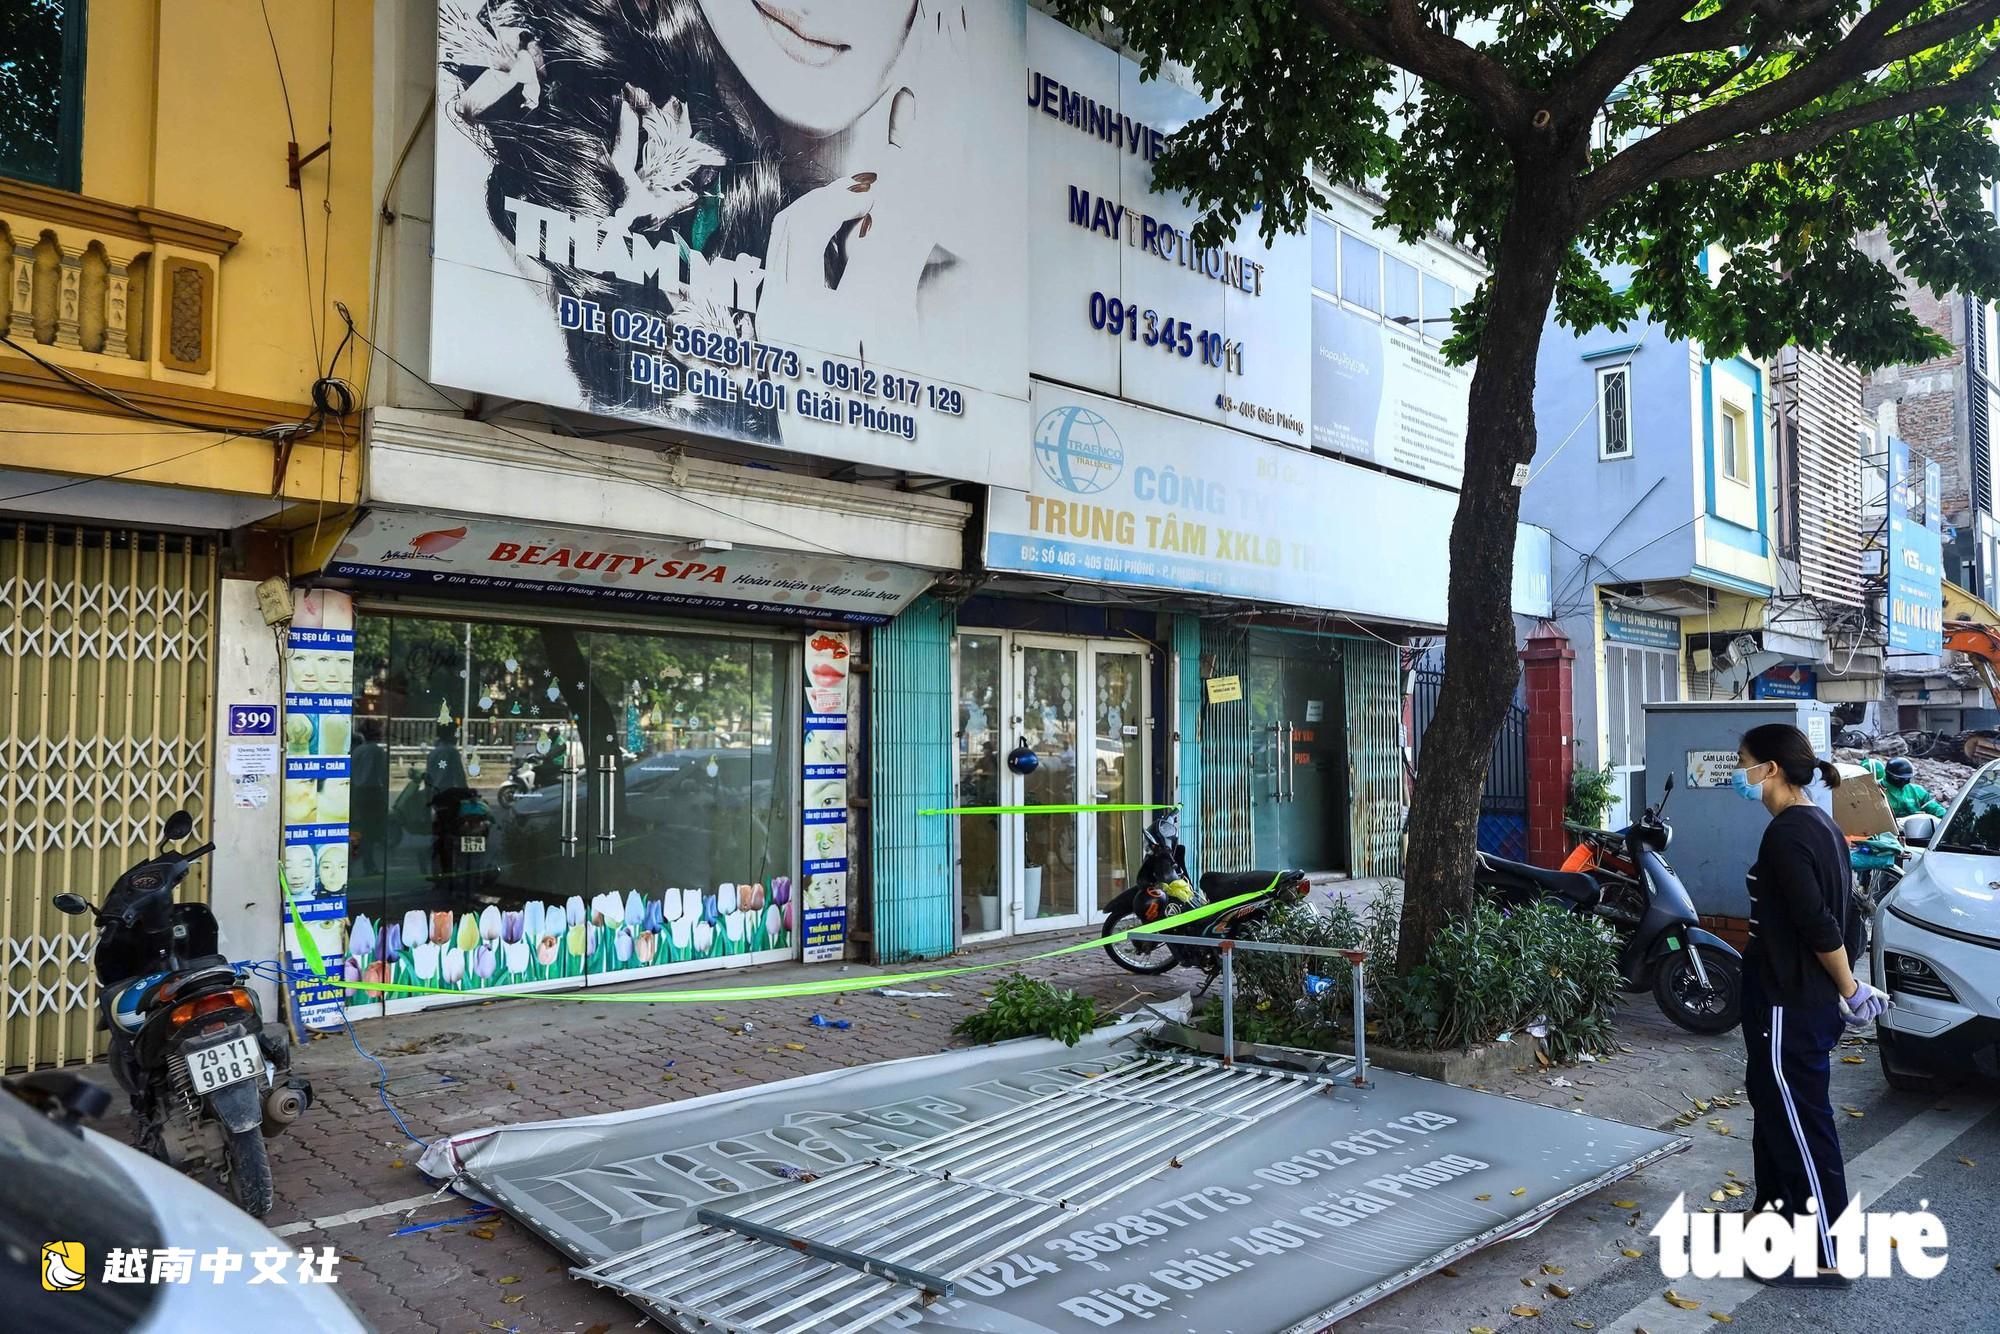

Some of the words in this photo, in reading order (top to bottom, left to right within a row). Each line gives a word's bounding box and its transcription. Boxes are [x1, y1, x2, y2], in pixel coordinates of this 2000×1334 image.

[559, 294, 606, 334] ĐT:
[612, 308, 667, 350] 024
[673, 324, 800, 379] 36281773
[821, 358, 878, 397] 0912
[881, 373, 920, 408] 817
[926, 384, 964, 416] 129
[630, 350, 680, 394] Địa
[686, 367, 737, 403] chỉ:
[743, 377, 787, 413] 401
[796, 388, 843, 424] Giải
[848, 400, 917, 440] Phóng
[1215, 393, 1232, 412] 403
[1239, 401, 1256, 419] 405
[1257, 406, 1275, 425] Giải
[1276, 411, 1304, 436] Phóng
[1067, 439, 1122, 460] TRAENCO
[1134, 464, 1227, 515] CÔNG
[1516, 467, 1528, 478] 235
[1025, 494, 1136, 545] TRUNG
[1145, 513, 1207, 557] TÂM
[338, 566, 412, 579] 0912817129
[487, 542, 657, 577] BEAUTY
[654, 560, 727, 583] SPA
[1041, 545, 1055, 564] SỐ
[1057, 551, 1075, 567] 403
[1085, 556, 1101, 571] 405
[1124, 558, 1154, 577] PHÓNG
[732, 574, 772, 586] Hoàn
[826, 584, 851, 596] đẹp
[851, 588, 876, 598] của
[876, 590, 901, 602] bạn
[235, 712, 271, 729] 399
[197, 1039, 249, 1071] 29-Y1
[202, 1057, 256, 1088] 9883
[1044, 1186, 1253, 1262] 36281773
[1253, 1148, 1357, 1186] 0912
[1330, 1128, 1406, 1156] 817
[1386, 1110, 1458, 1135] 129
[1057, 1281, 1171, 1327] Địa
[1149, 1247, 1255, 1291] chỉ:
[1228, 1219, 1324, 1256] 401
[1299, 1188, 1397, 1227] Giải
[1363, 1153, 1490, 1199] Phóng
